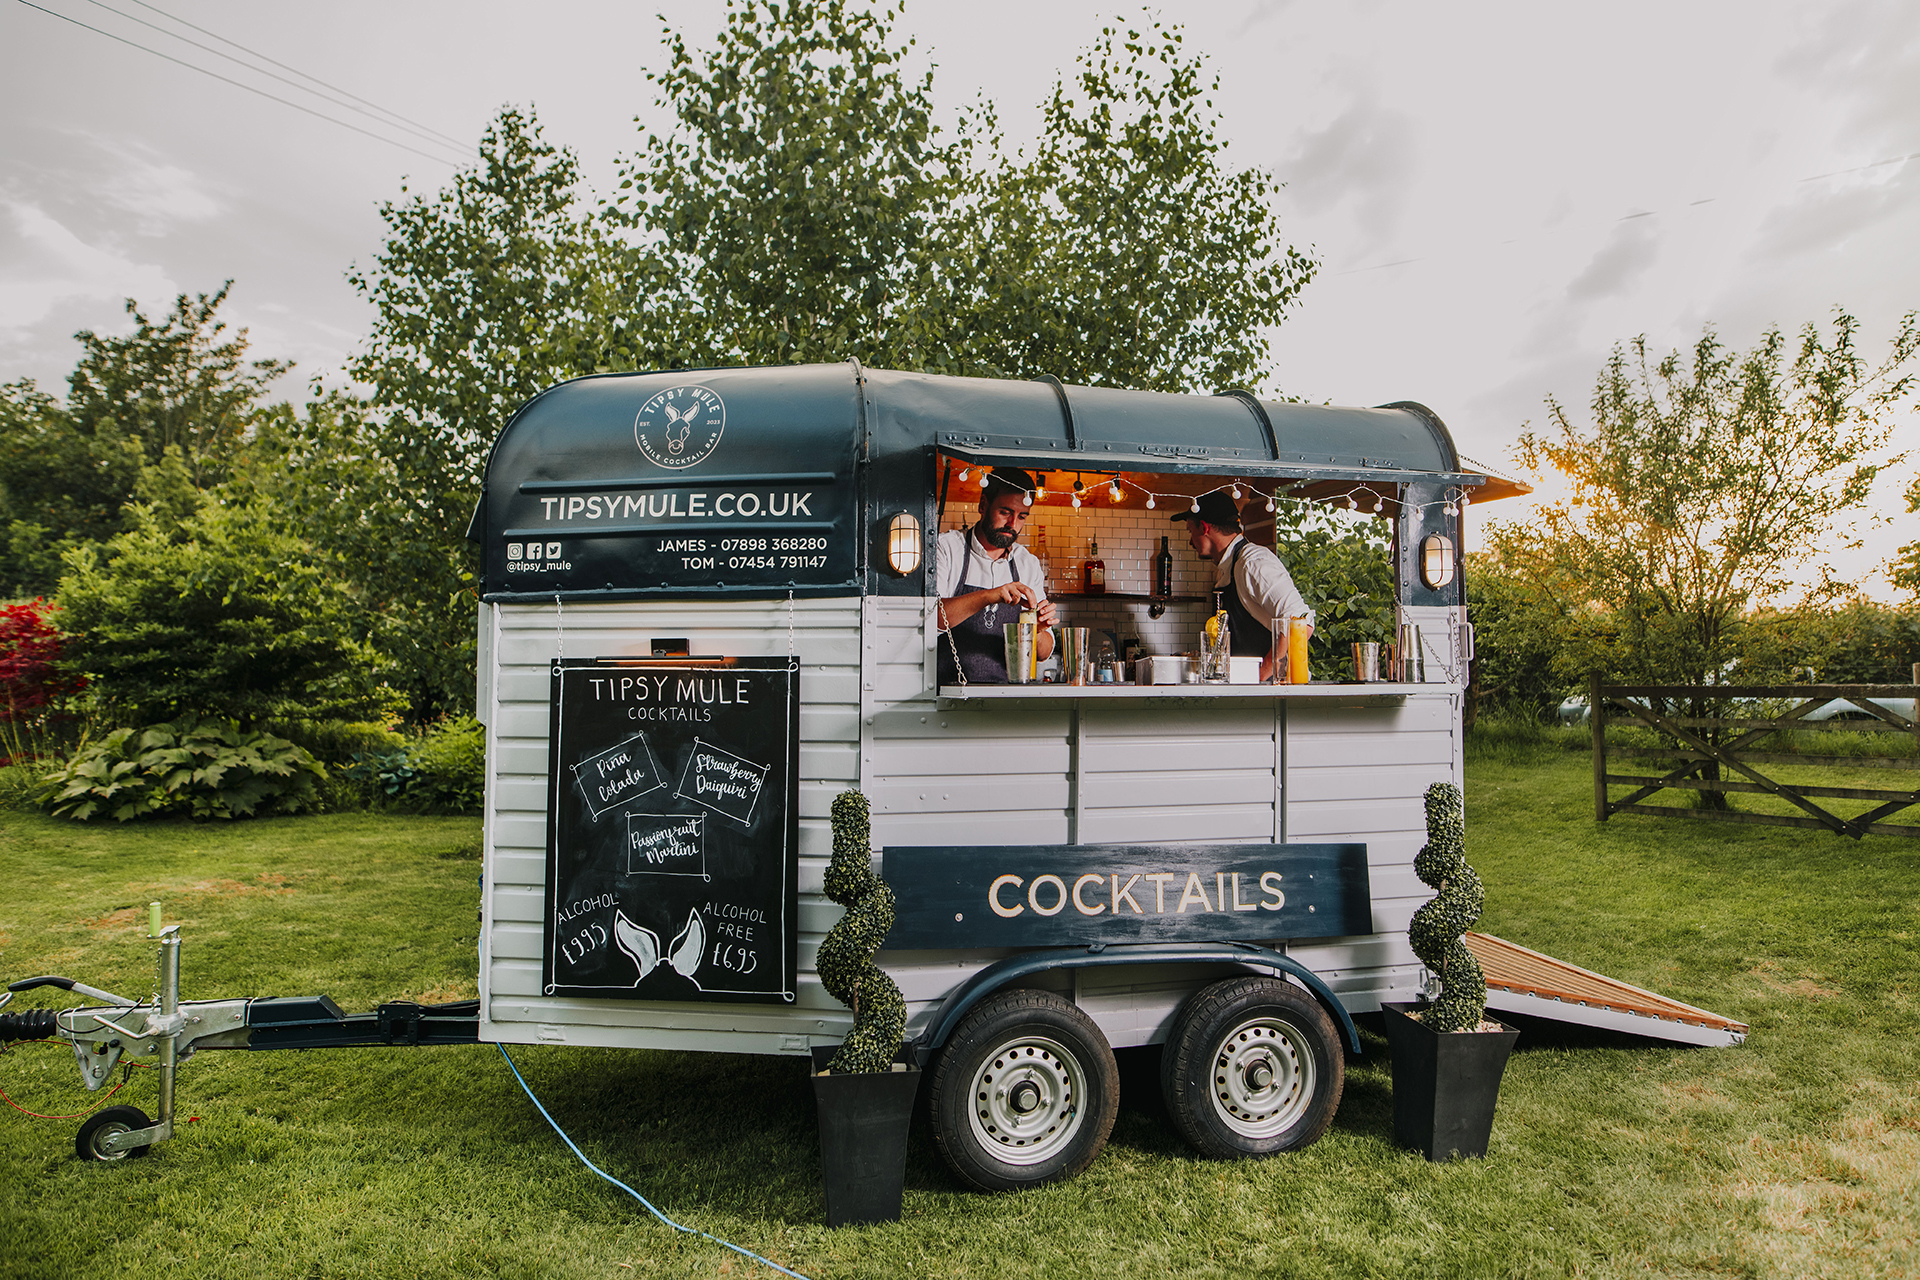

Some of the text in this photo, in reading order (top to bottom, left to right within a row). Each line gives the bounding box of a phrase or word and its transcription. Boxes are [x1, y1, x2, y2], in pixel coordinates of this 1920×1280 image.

[644, 387, 721, 414] TIPSY MULE
[640, 432, 717, 465] MOBILE COCKTAIL BAR
[540, 492, 812, 521] TIPSYMULE.CO.UK
[656, 539, 707, 554] JAMES
[721, 538, 767, 552] 07898
[771, 537, 827, 551] 368280
[506, 560, 572, 573] @tipsy_mule
[681, 557, 714, 570] TOM
[729, 556, 775, 570] 07454
[779, 555, 827, 569] 791147
[589, 675, 751, 704] TIPSY MULE
[627, 706, 712, 723] COCKTAILS
[598, 768, 645, 802] Colada
[696, 753, 761, 793] Strawberry
[696, 774, 748, 800] Daiquiri
[631, 819, 702, 849] Passionfruit
[646, 841, 700, 864] Martini
[987, 870, 1286, 918] COCKTAILS
[558, 893, 620, 925] ALCOHOL
[703, 901, 767, 924] ALCOHOL
[561, 922, 607, 966] £9.95
[717, 922, 754, 942] FREE
[712, 942, 757, 974] £6.95
